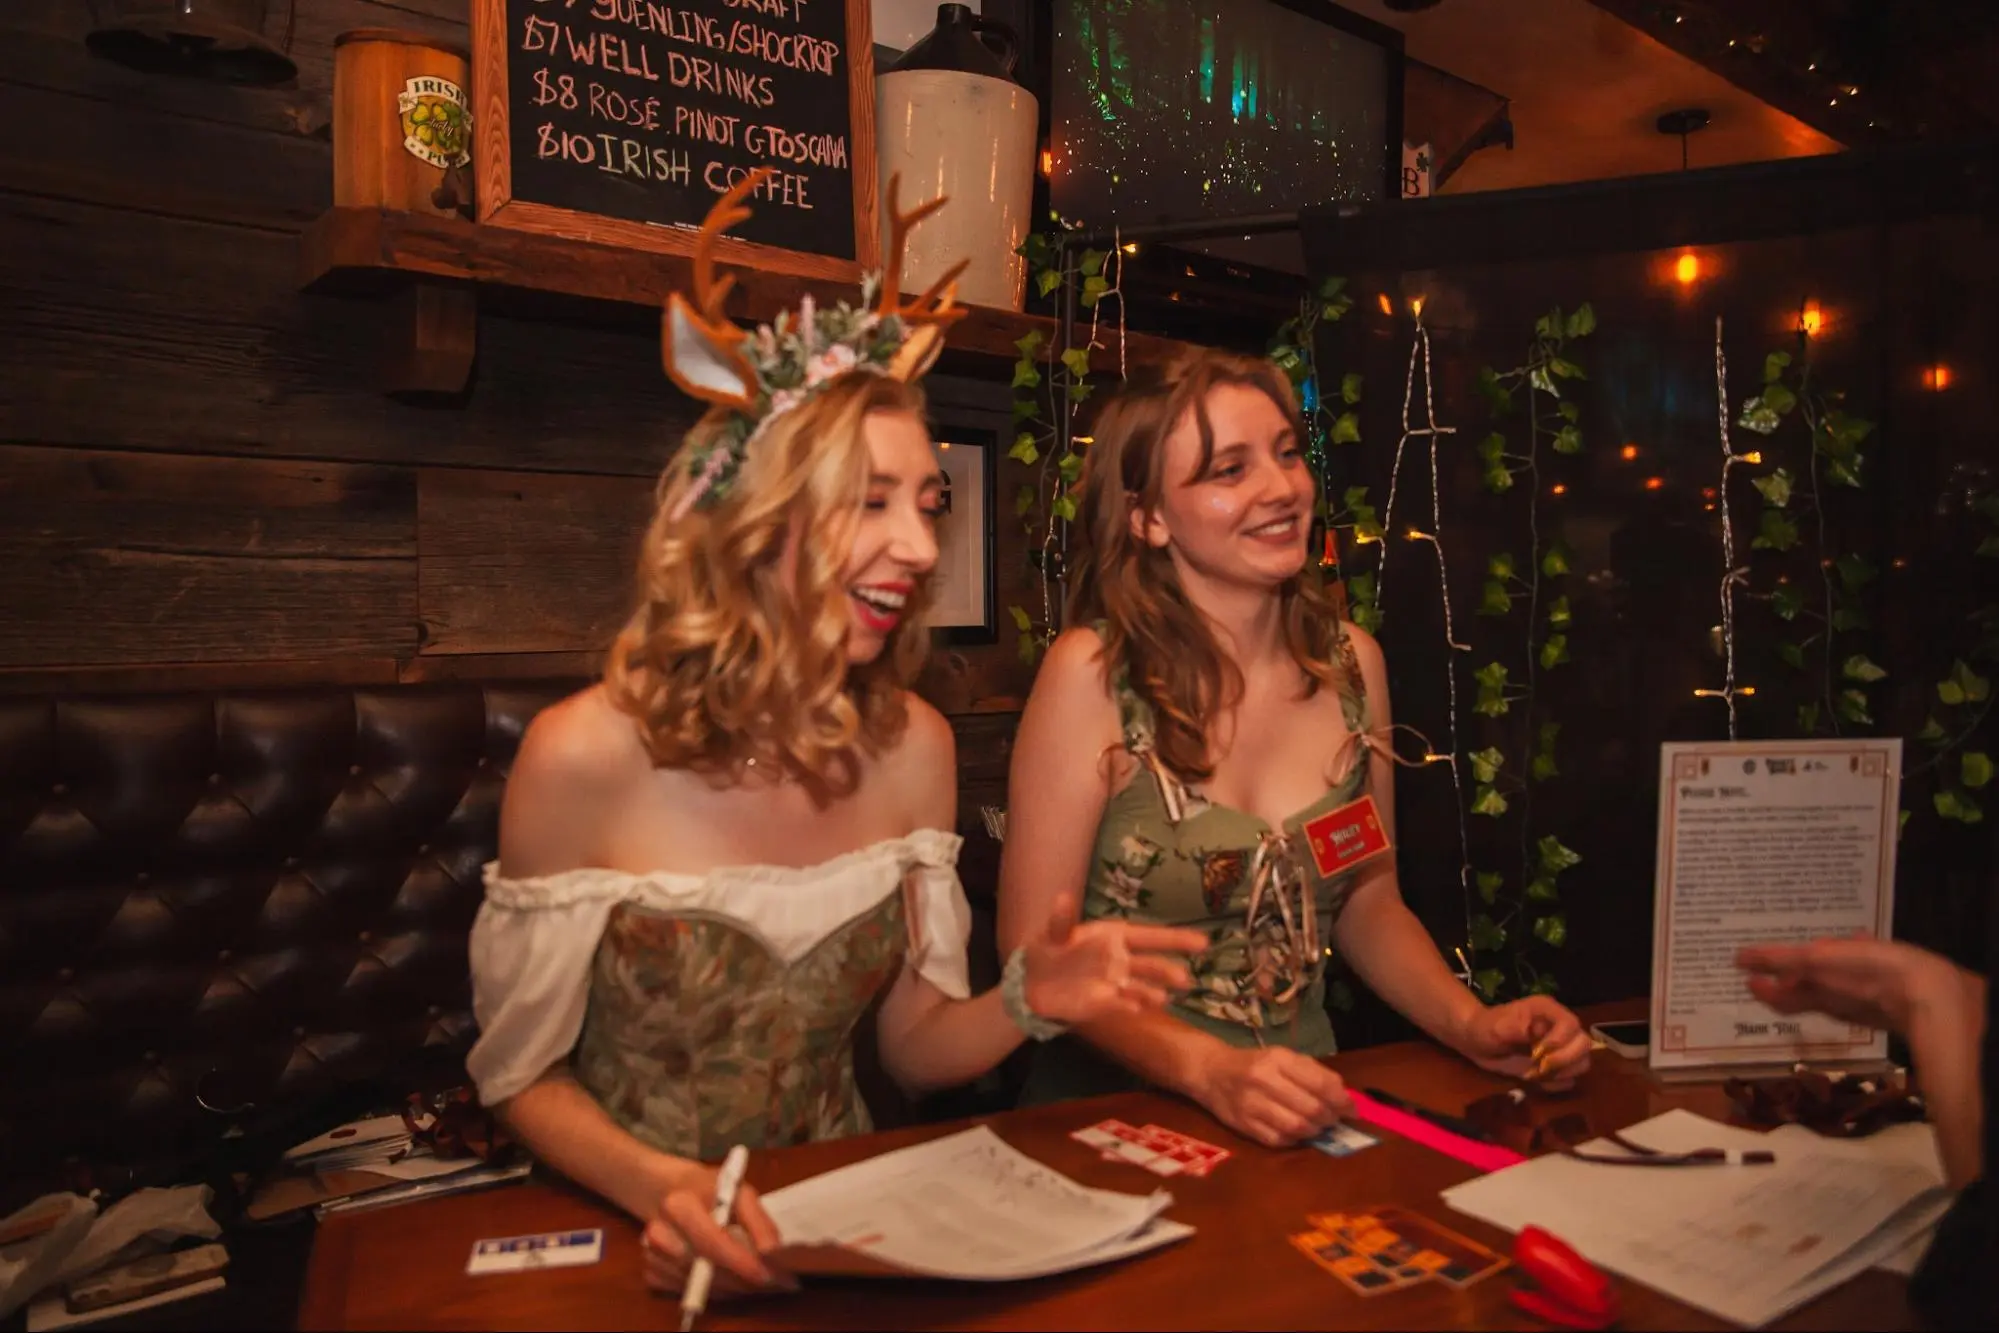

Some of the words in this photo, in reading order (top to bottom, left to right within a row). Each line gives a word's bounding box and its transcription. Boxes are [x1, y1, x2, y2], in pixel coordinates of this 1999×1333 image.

[413, 79, 466, 107] IRISH
[522, 14, 559, 56] $7
[565, 26, 659, 81] WELL
[668, 51, 774, 108] DRINKS
[532, 68, 578, 110] $8
[676, 106, 740, 147] PINOT
[537, 122, 595, 163] $10
[596, 133, 691, 187] IRISH
